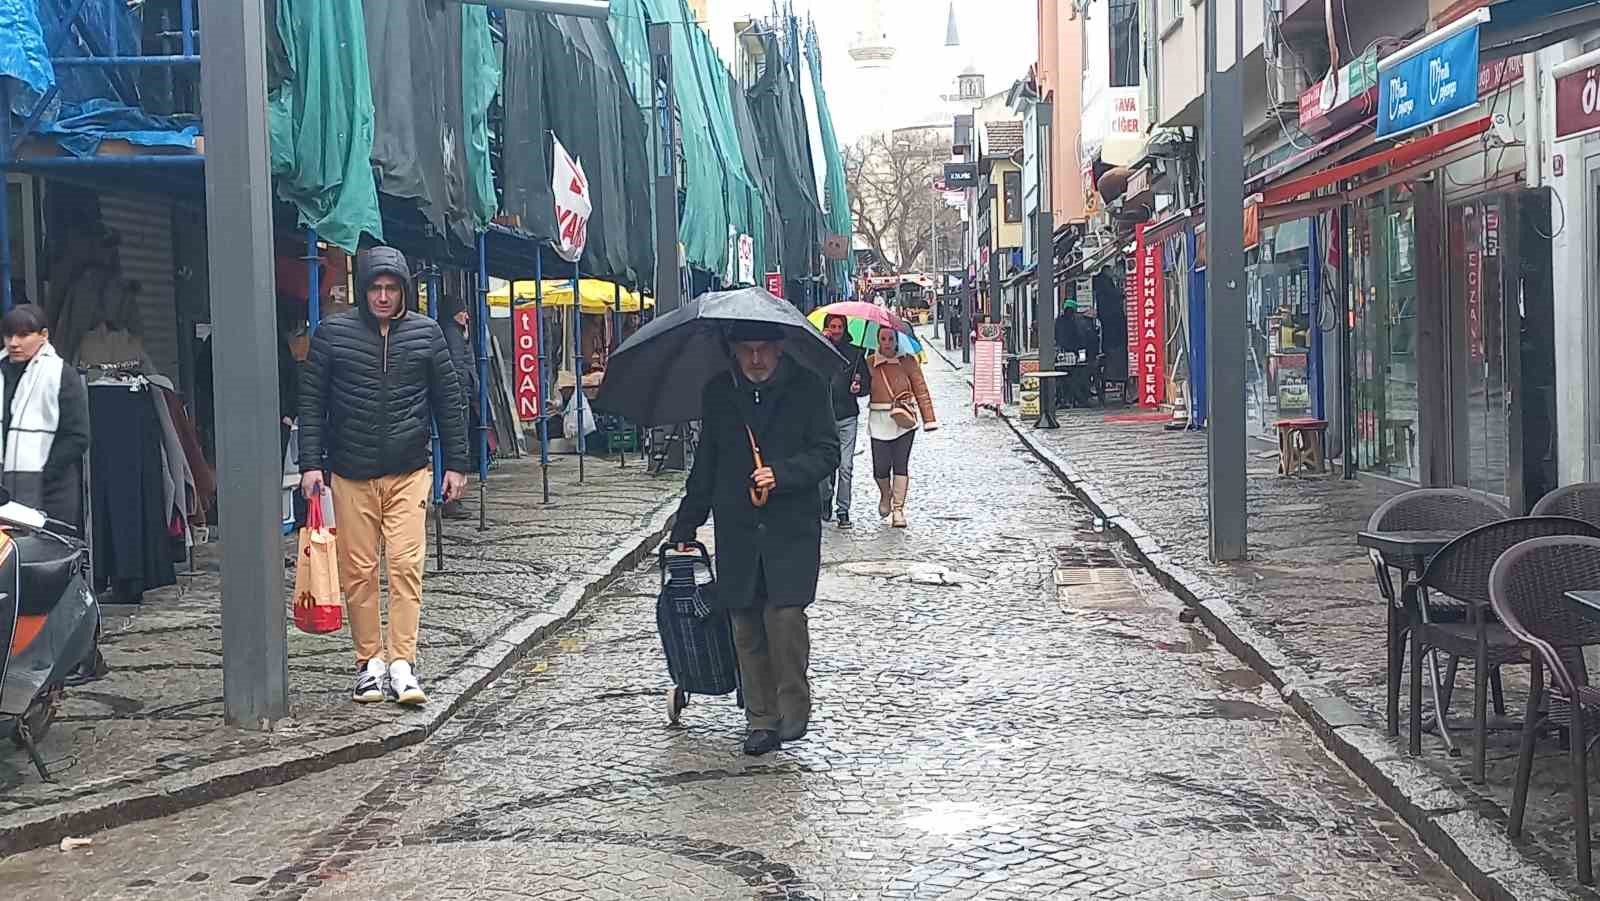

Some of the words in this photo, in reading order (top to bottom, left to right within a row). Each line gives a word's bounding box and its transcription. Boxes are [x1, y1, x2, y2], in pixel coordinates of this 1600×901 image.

[1582, 69, 1600, 114] Ö
[1143, 243, 1156, 338] ТЕРИНАРНА
[519, 313, 538, 416] toCAN
[1144, 343, 1156, 404] АПТЕКА
